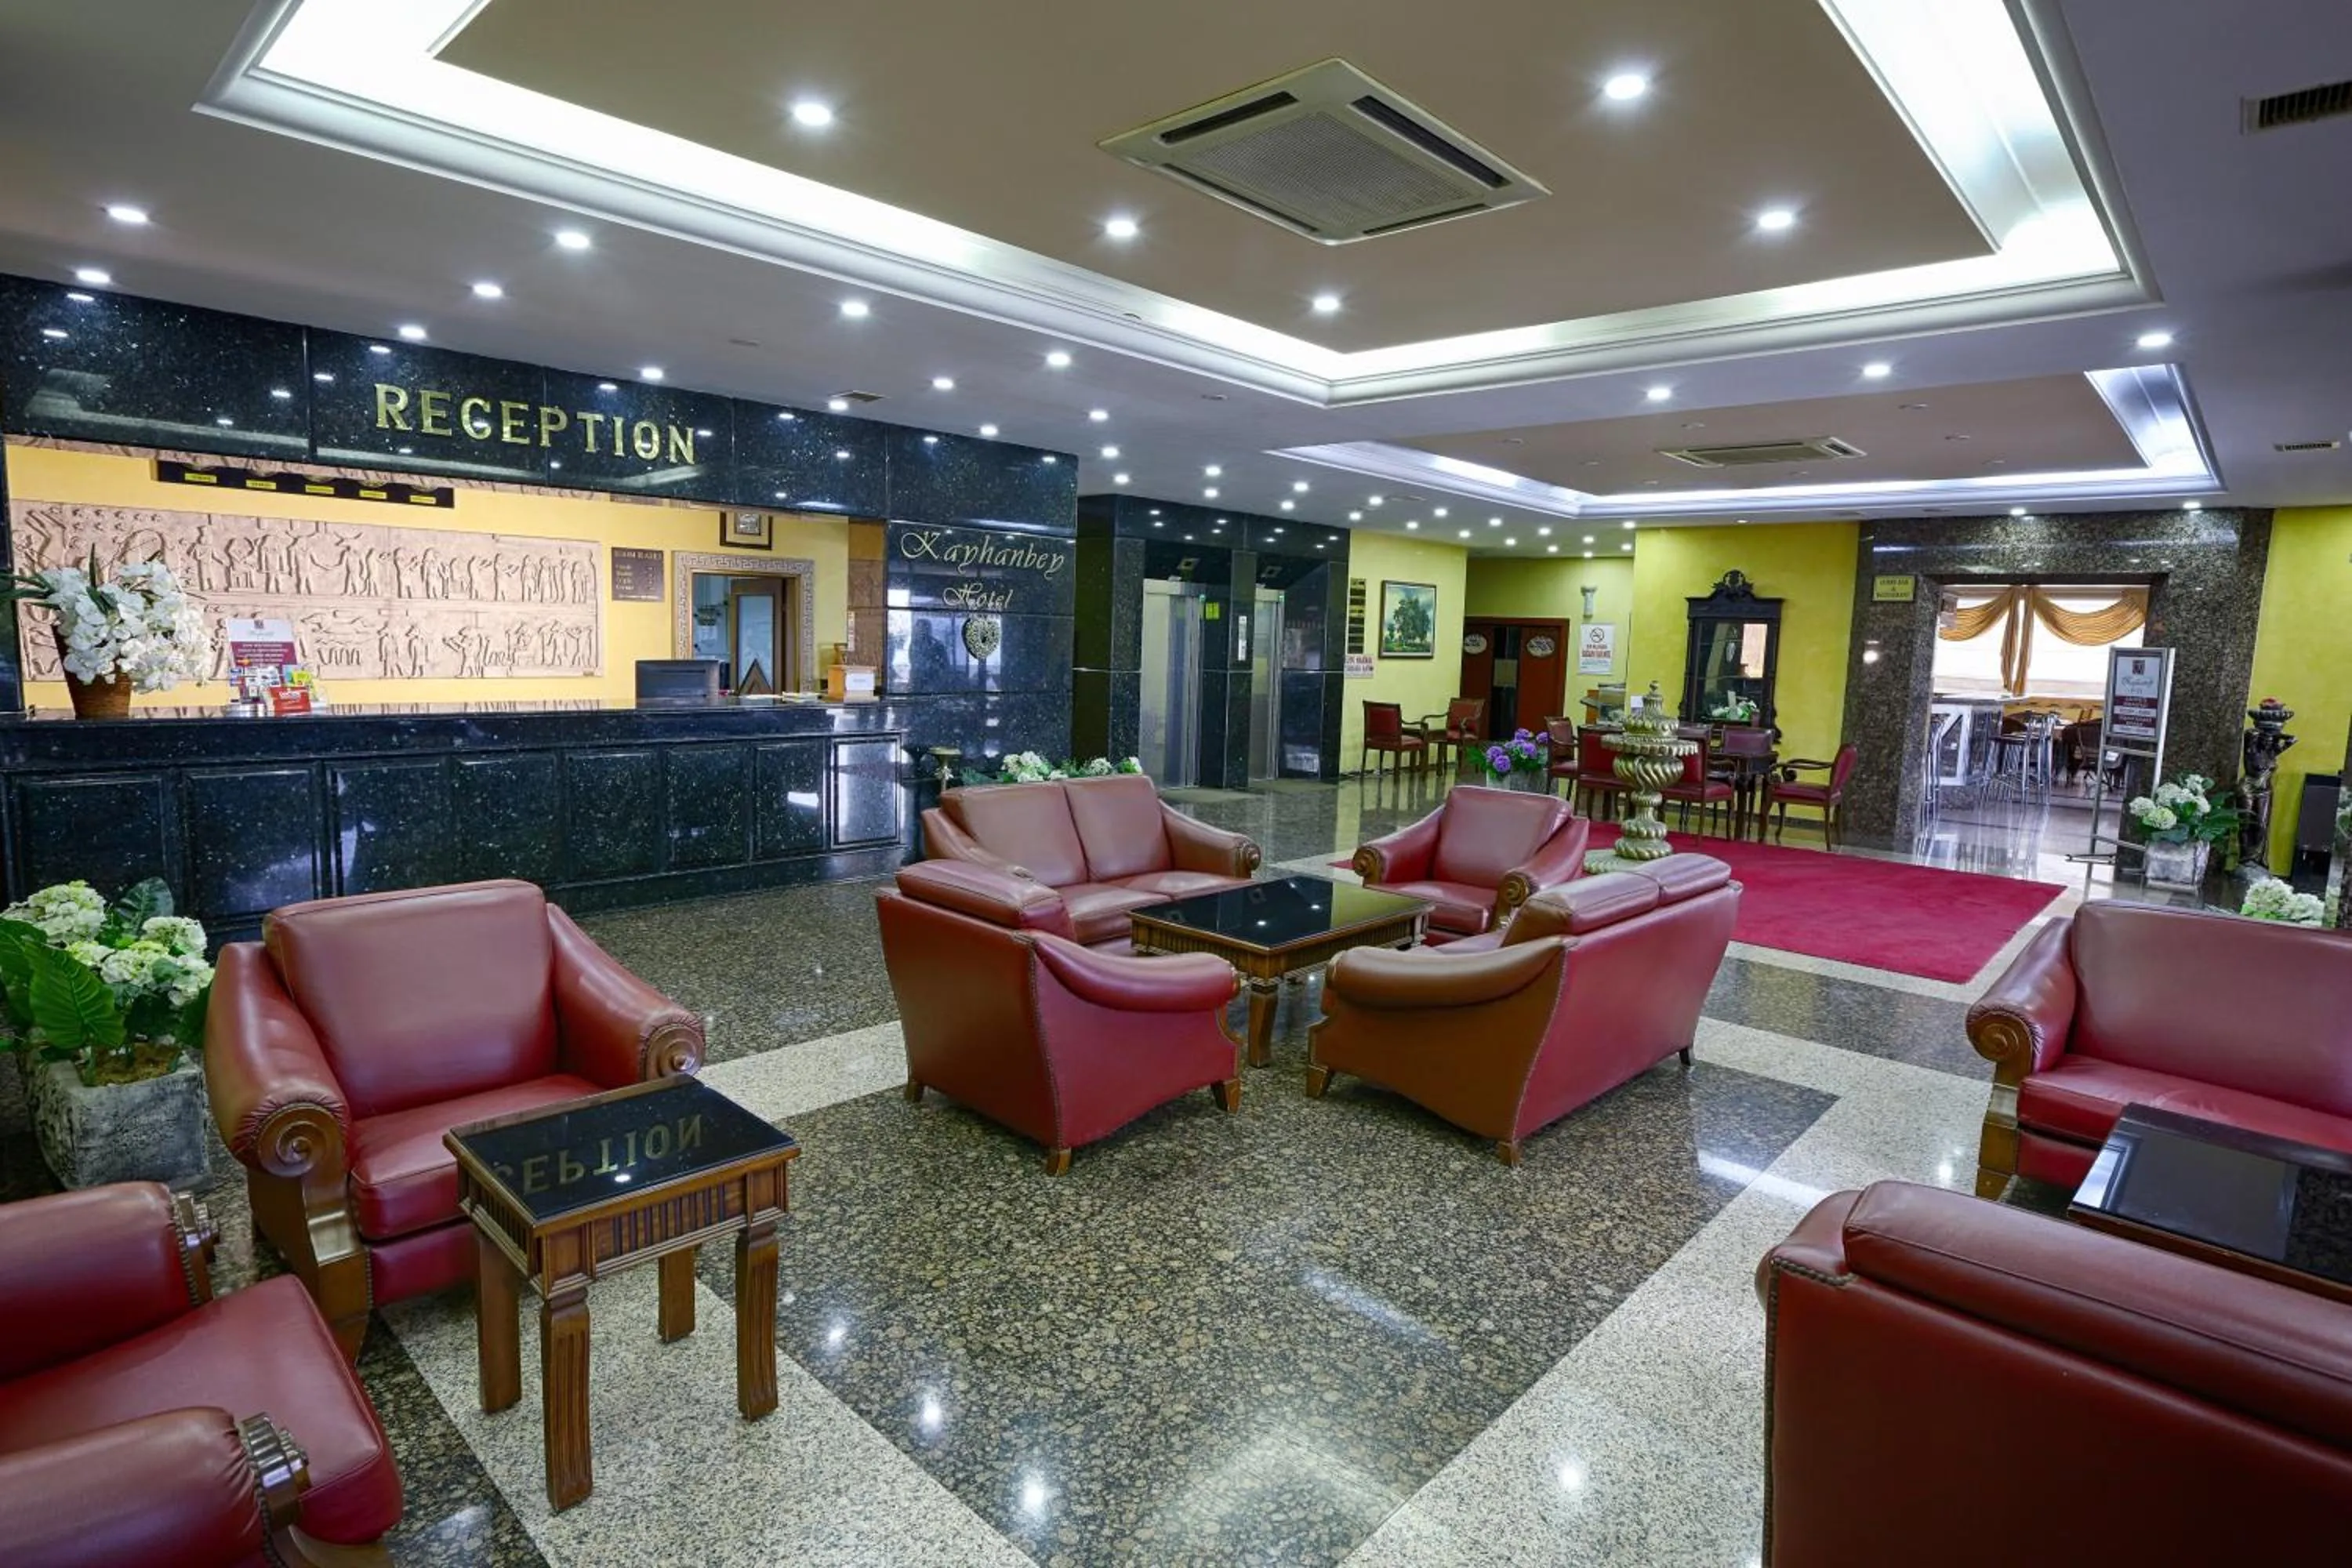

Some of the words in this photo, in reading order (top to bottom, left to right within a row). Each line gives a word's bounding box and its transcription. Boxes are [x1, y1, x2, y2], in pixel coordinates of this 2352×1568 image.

[374, 383, 695, 465] RECEPTION
[900, 531, 1065, 581] Kayhanbey
[942, 583, 1014, 609] Hotel
